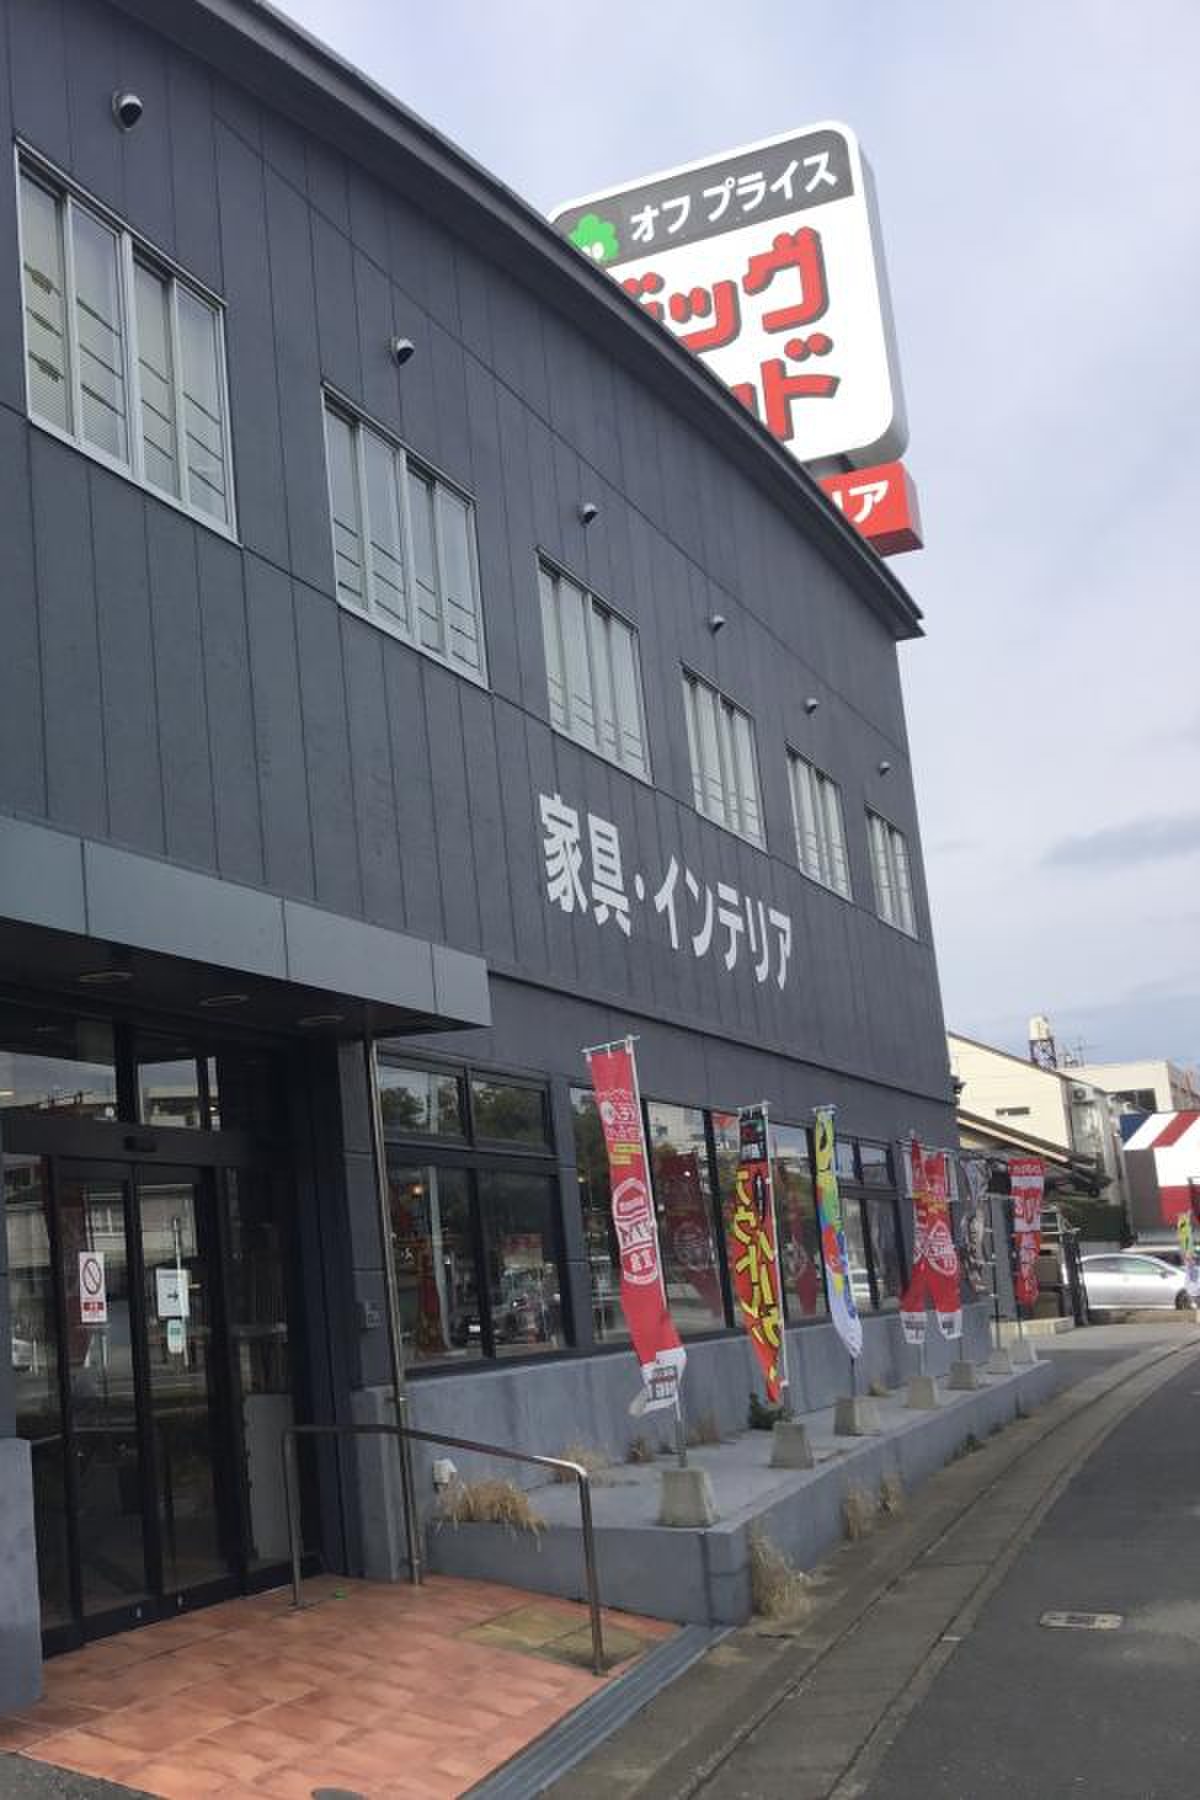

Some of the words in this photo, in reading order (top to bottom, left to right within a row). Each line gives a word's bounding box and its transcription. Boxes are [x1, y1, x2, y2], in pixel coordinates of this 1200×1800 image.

[538, 793, 791, 990] 家具・インテリア
